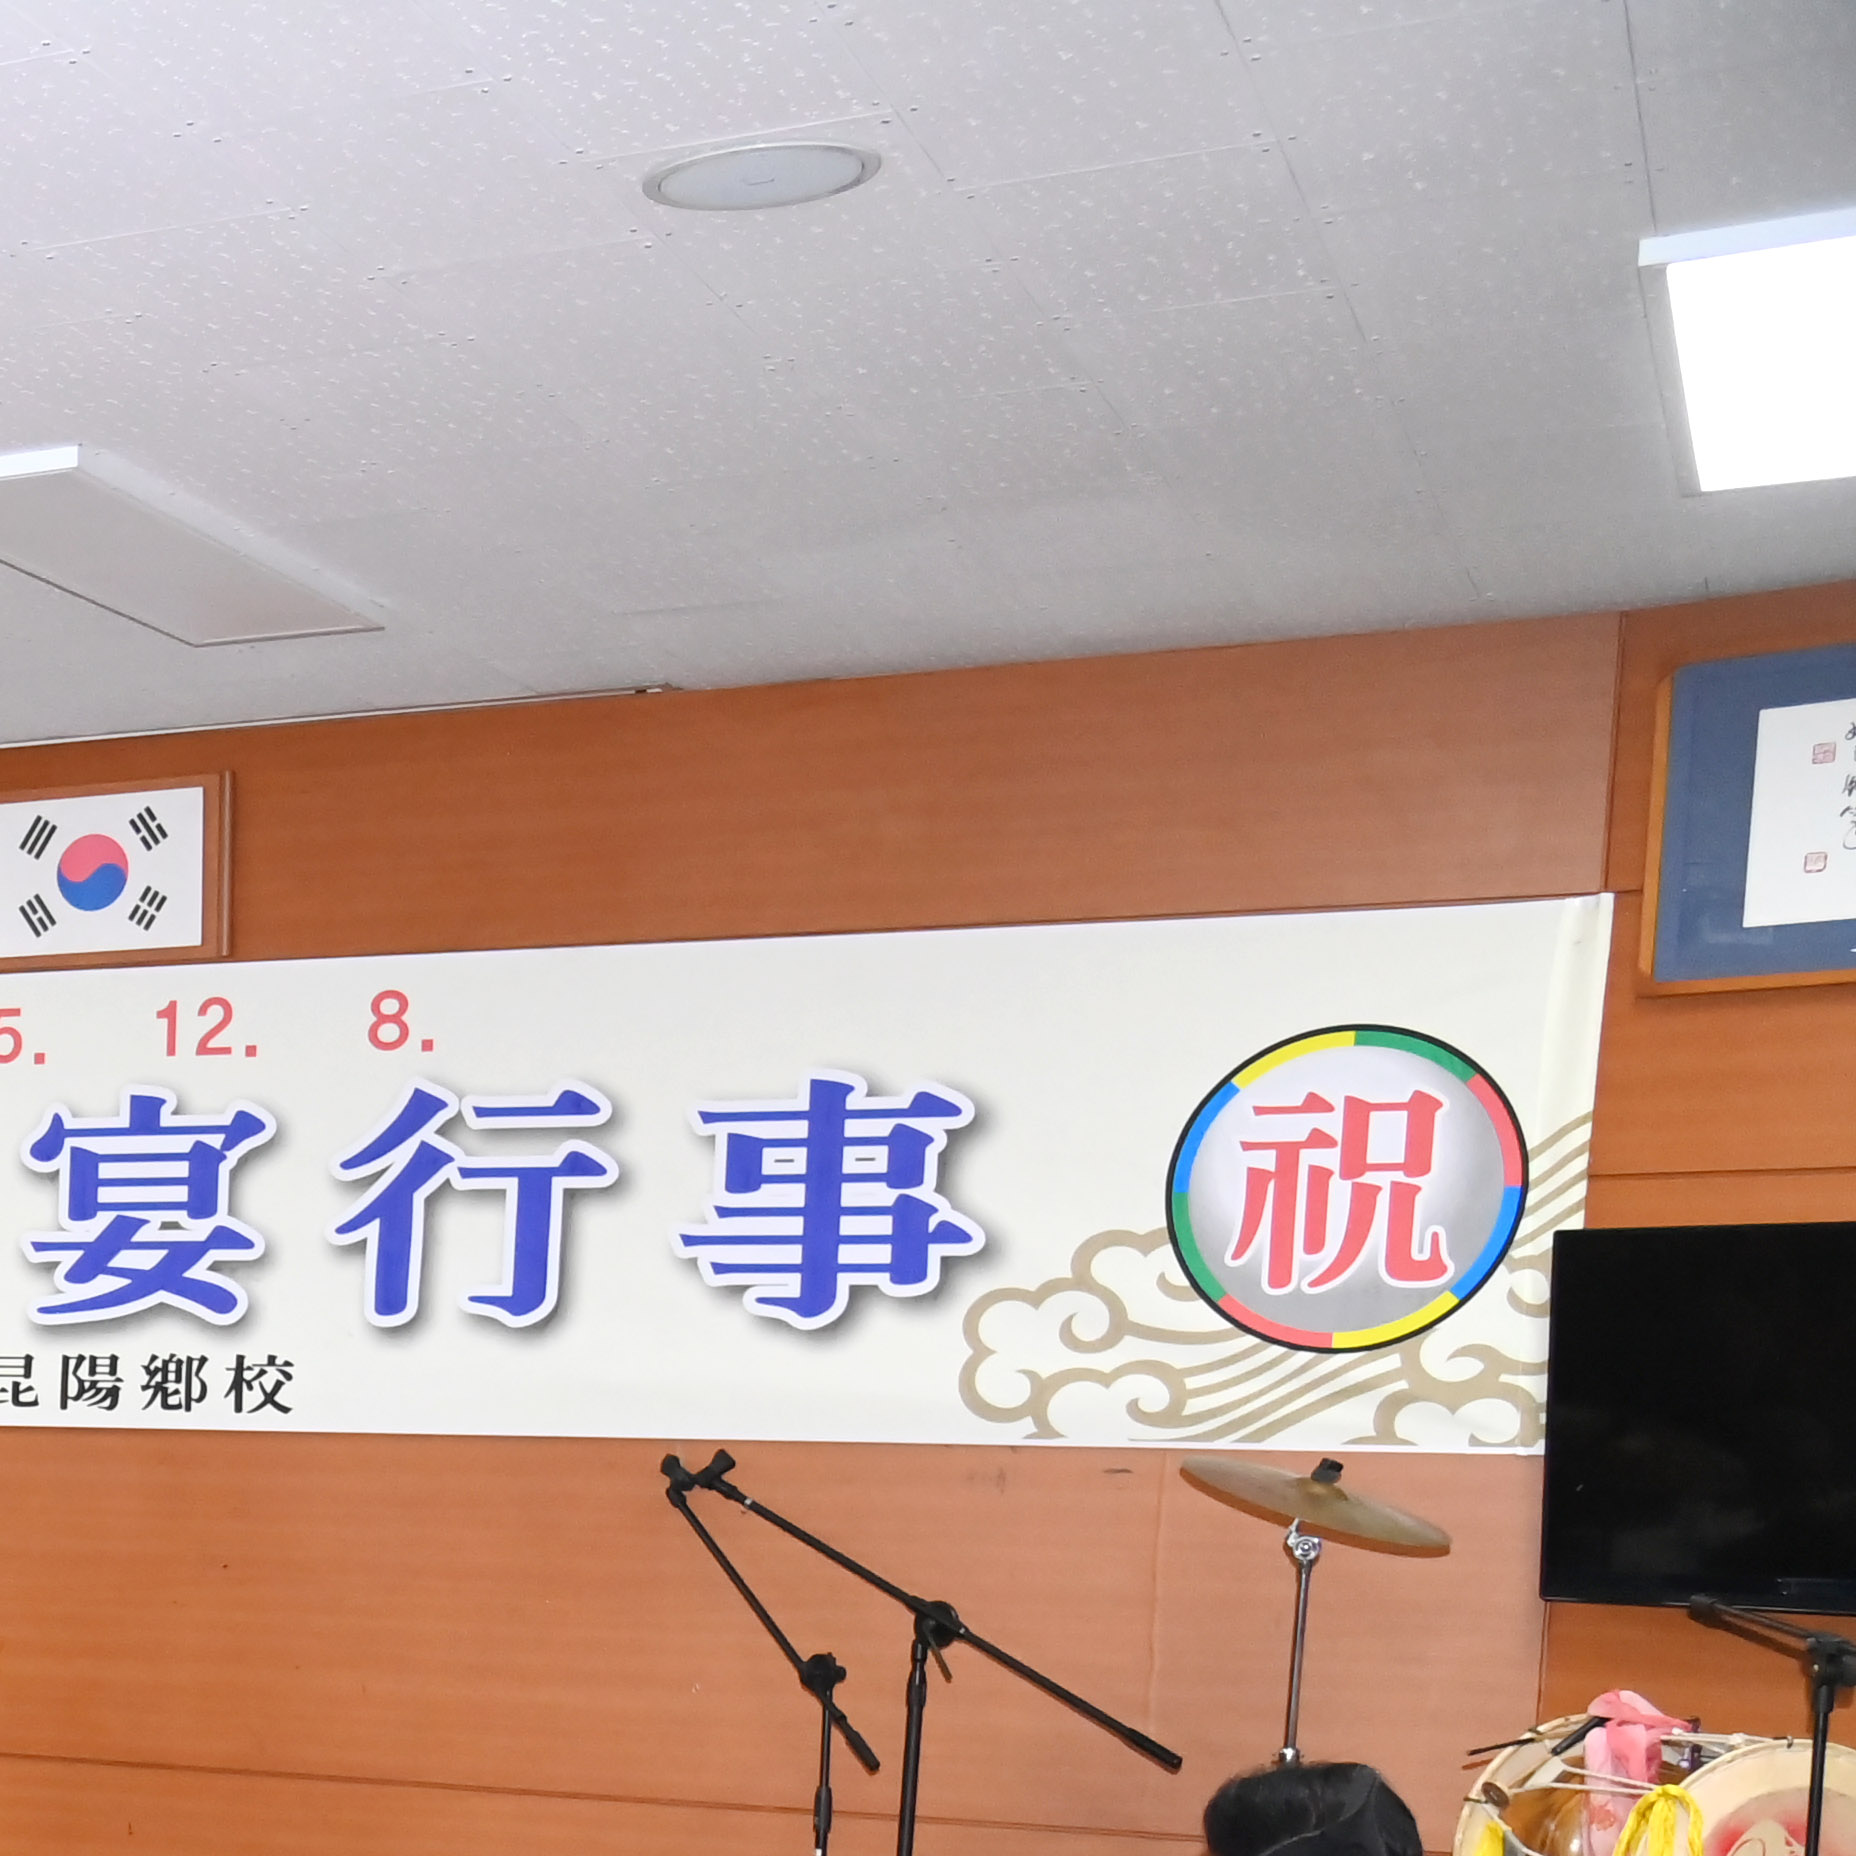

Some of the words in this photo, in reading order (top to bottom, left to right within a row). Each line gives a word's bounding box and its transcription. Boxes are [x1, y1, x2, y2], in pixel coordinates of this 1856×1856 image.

[156, 996, 259, 1058] 12.
[368, 989, 435, 1052] 8.
[1223, 1087, 1455, 1297] 祝
